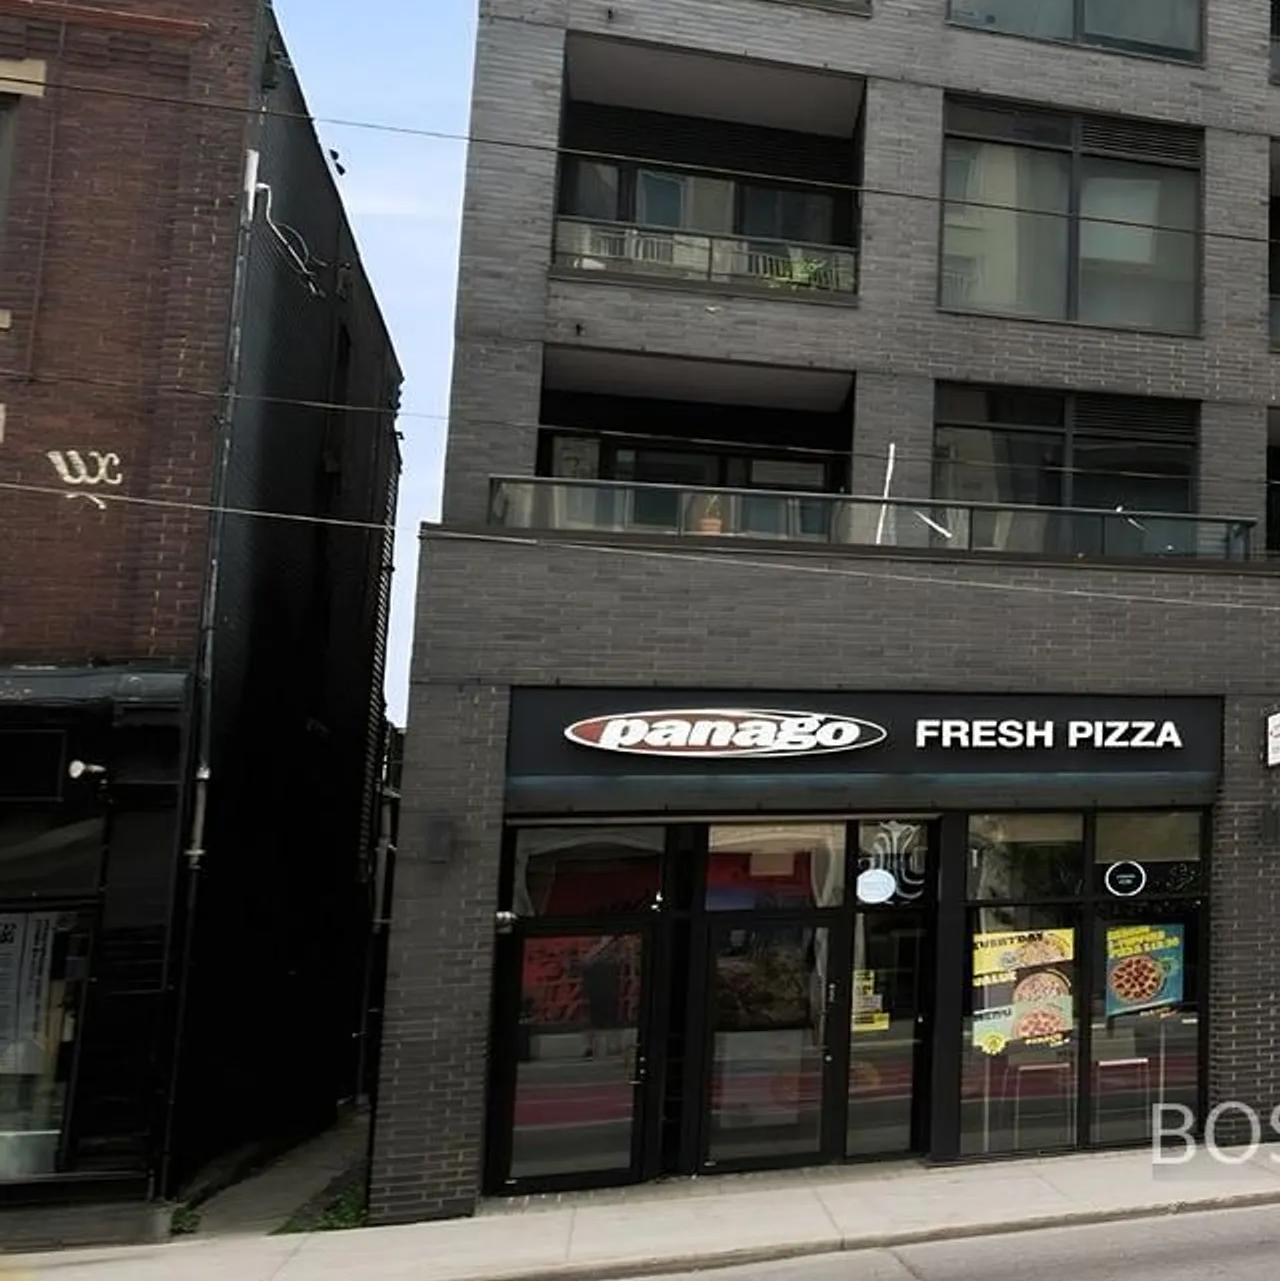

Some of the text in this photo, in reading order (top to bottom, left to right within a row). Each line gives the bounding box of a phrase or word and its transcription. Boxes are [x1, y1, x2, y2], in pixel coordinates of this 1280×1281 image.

[599, 716, 861, 750] panago
[915, 720, 1183, 749] FRESH PIZZA
